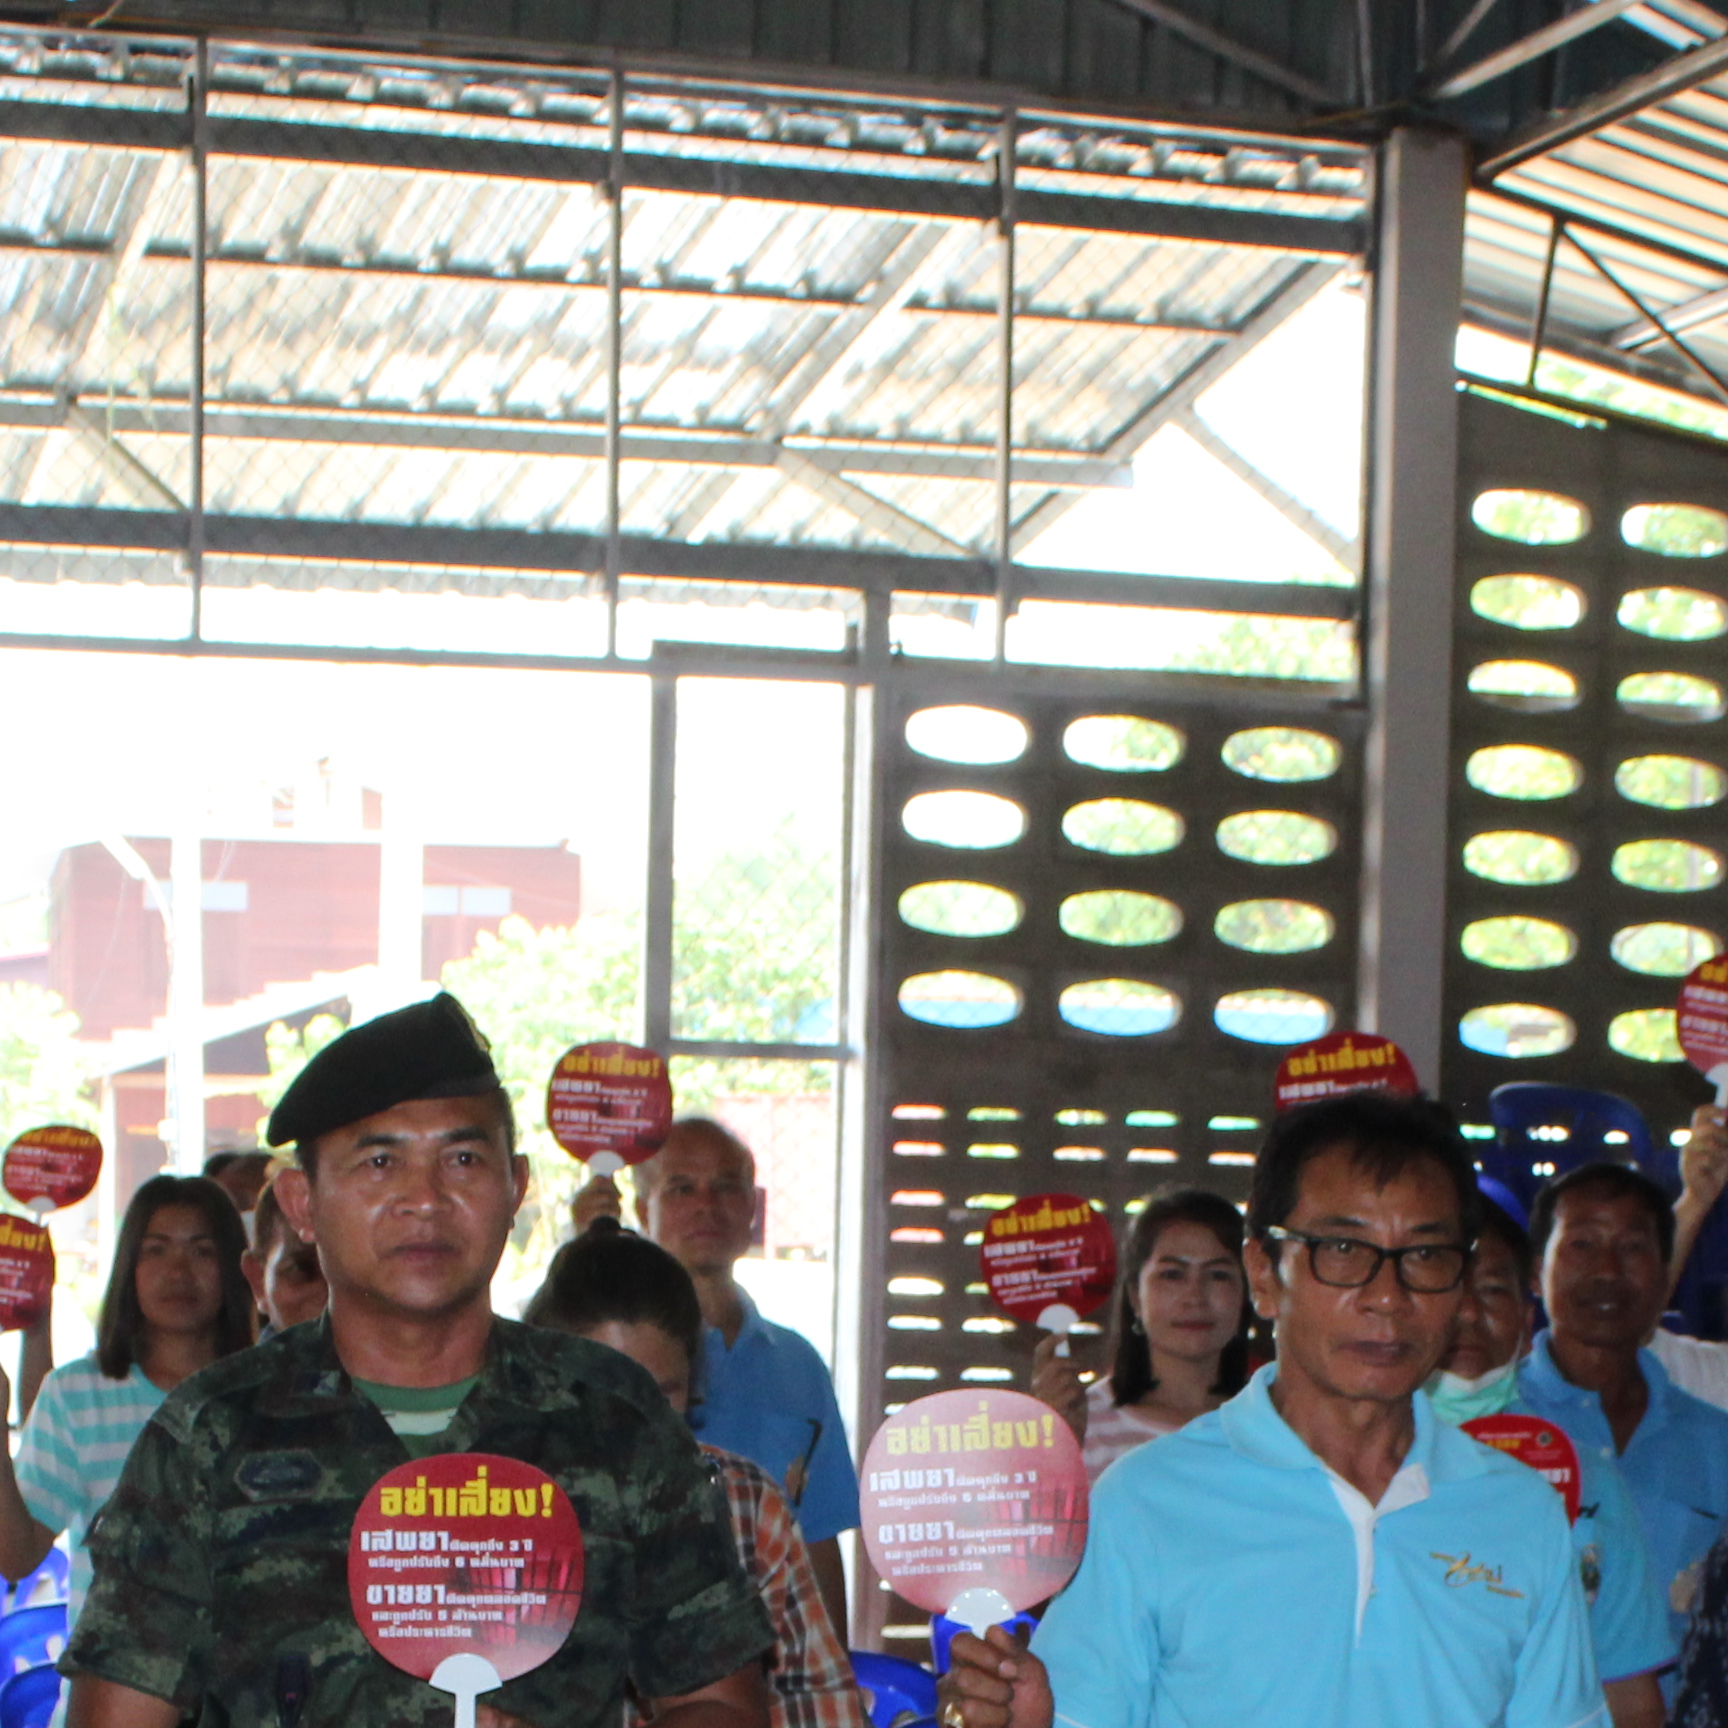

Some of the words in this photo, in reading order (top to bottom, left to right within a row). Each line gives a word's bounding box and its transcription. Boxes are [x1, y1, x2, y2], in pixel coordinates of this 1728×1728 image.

[380, 1465, 554, 1518] อย่าเสี่ยง!
[360, 1529, 450, 1552] เสพยา
[366, 1584, 446, 1605] ขายยา
